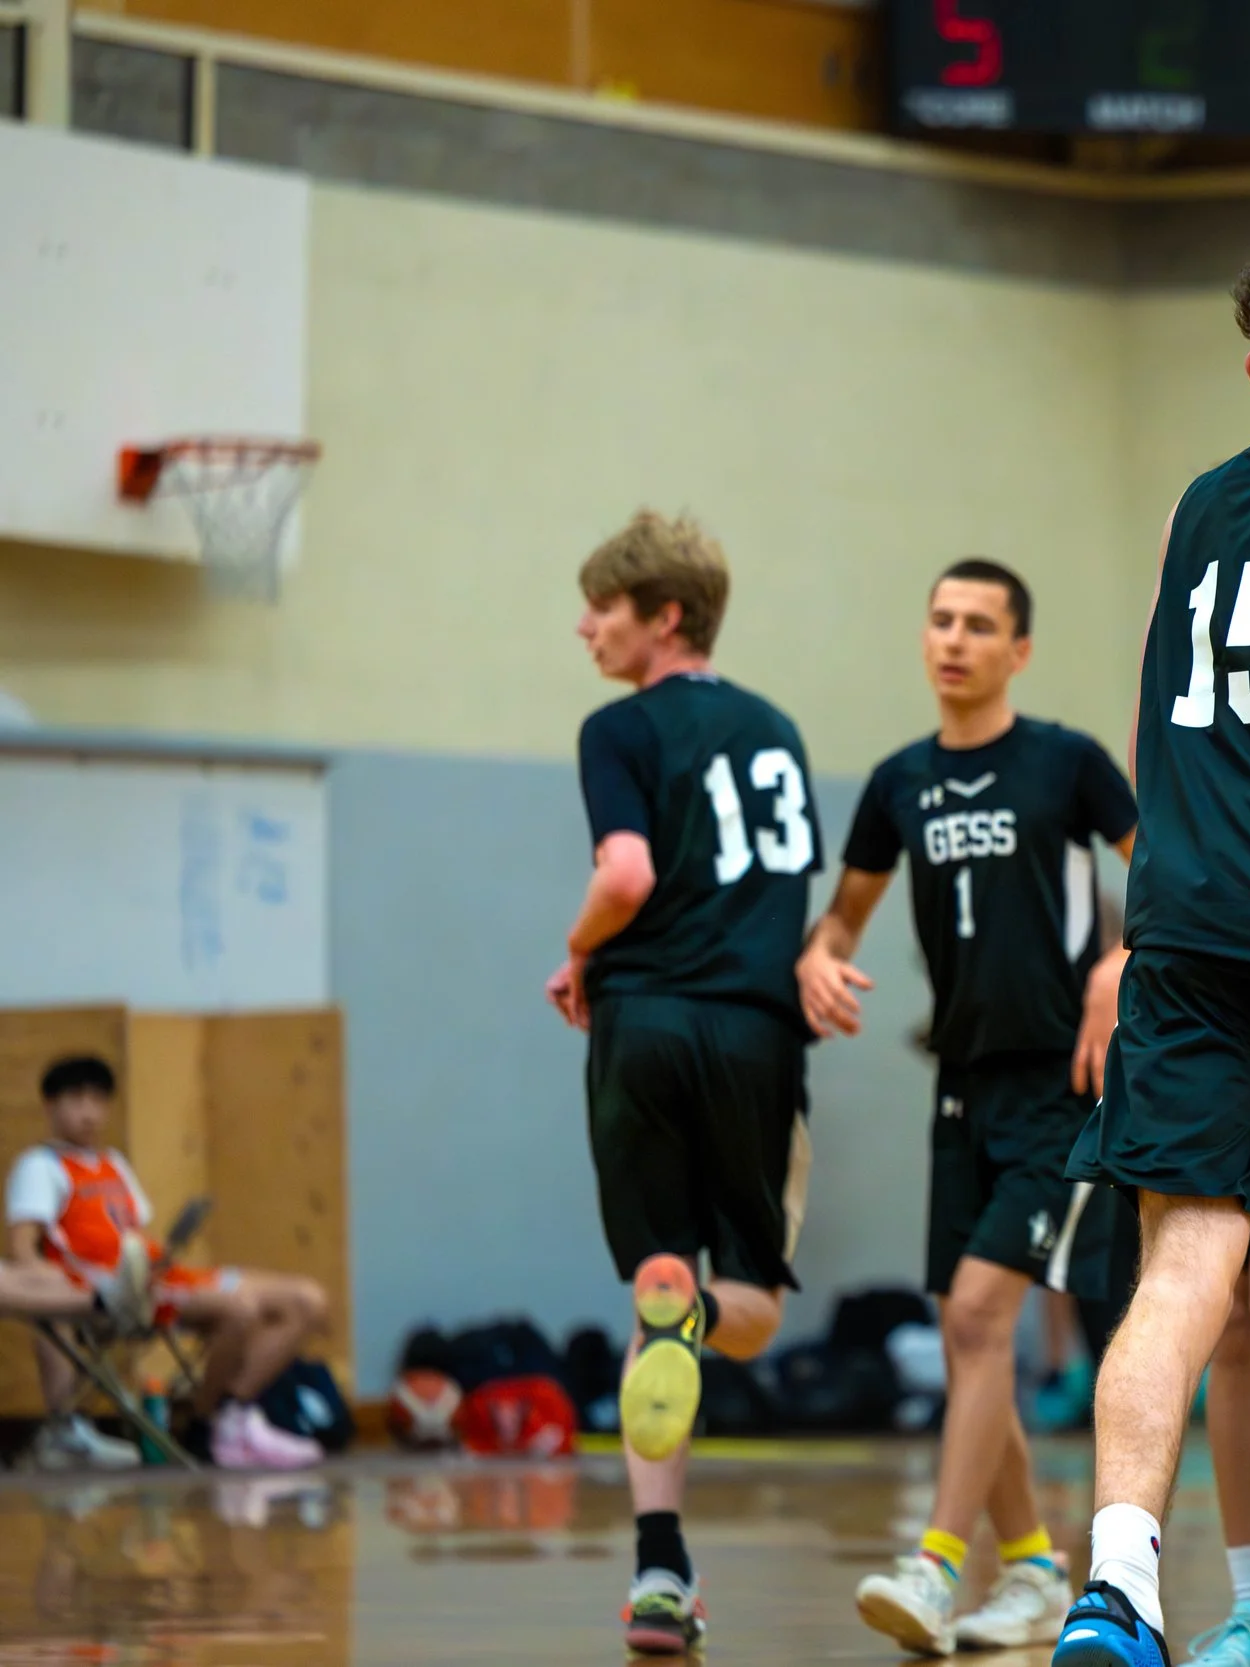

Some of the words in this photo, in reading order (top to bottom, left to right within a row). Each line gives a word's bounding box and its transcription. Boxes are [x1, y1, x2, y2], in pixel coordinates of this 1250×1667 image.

[703, 747, 814, 885] 13
[923, 808, 1018, 866] GESS
[954, 865, 976, 940] 1
